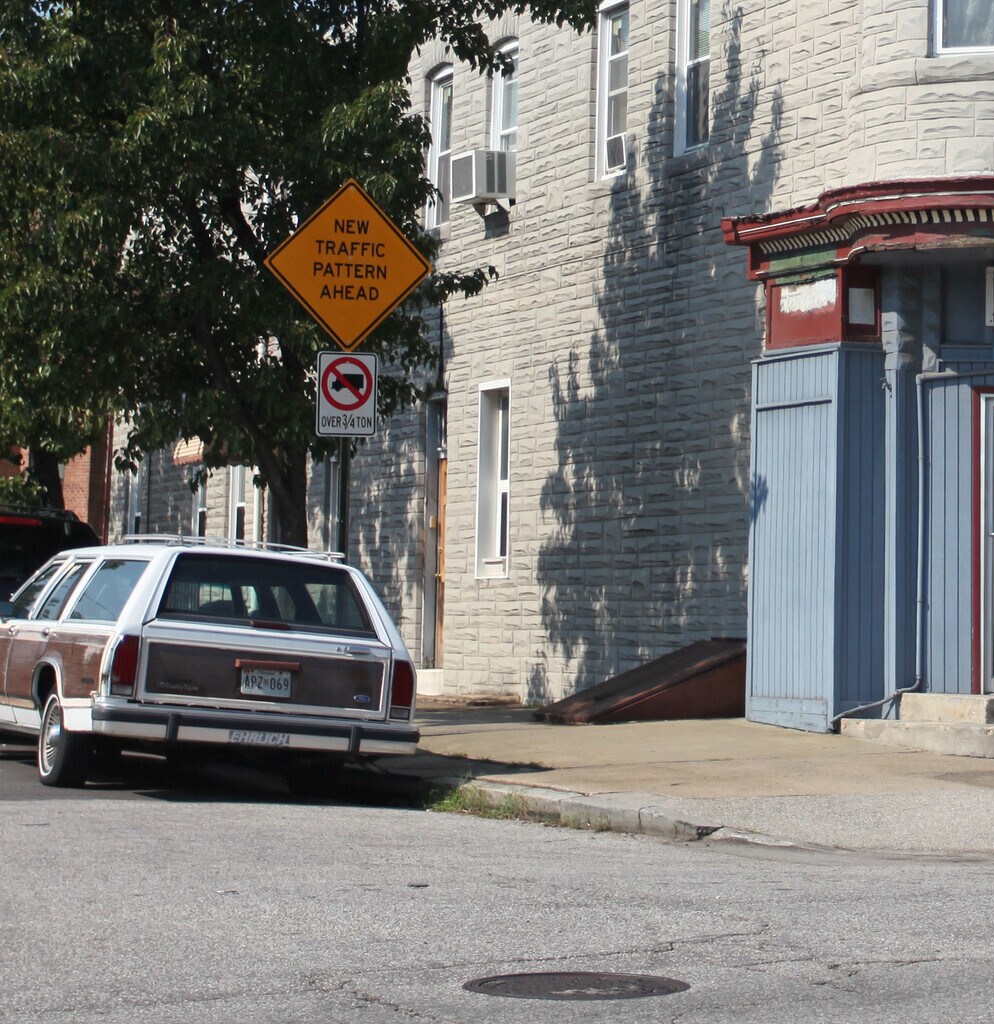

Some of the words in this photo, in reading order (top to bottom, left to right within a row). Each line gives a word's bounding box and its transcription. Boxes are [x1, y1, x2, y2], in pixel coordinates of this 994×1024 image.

[334, 219, 369, 235] NEW
[315, 240, 385, 258] TRAFFIC
[313, 262, 387, 280] PATTERN
[320, 285, 379, 301] AHEAD
[321, 416, 341, 428] OVER
[357, 416, 372, 428] TON
[244, 675, 263, 690] APZ
[270, 677, 289, 691] 069
